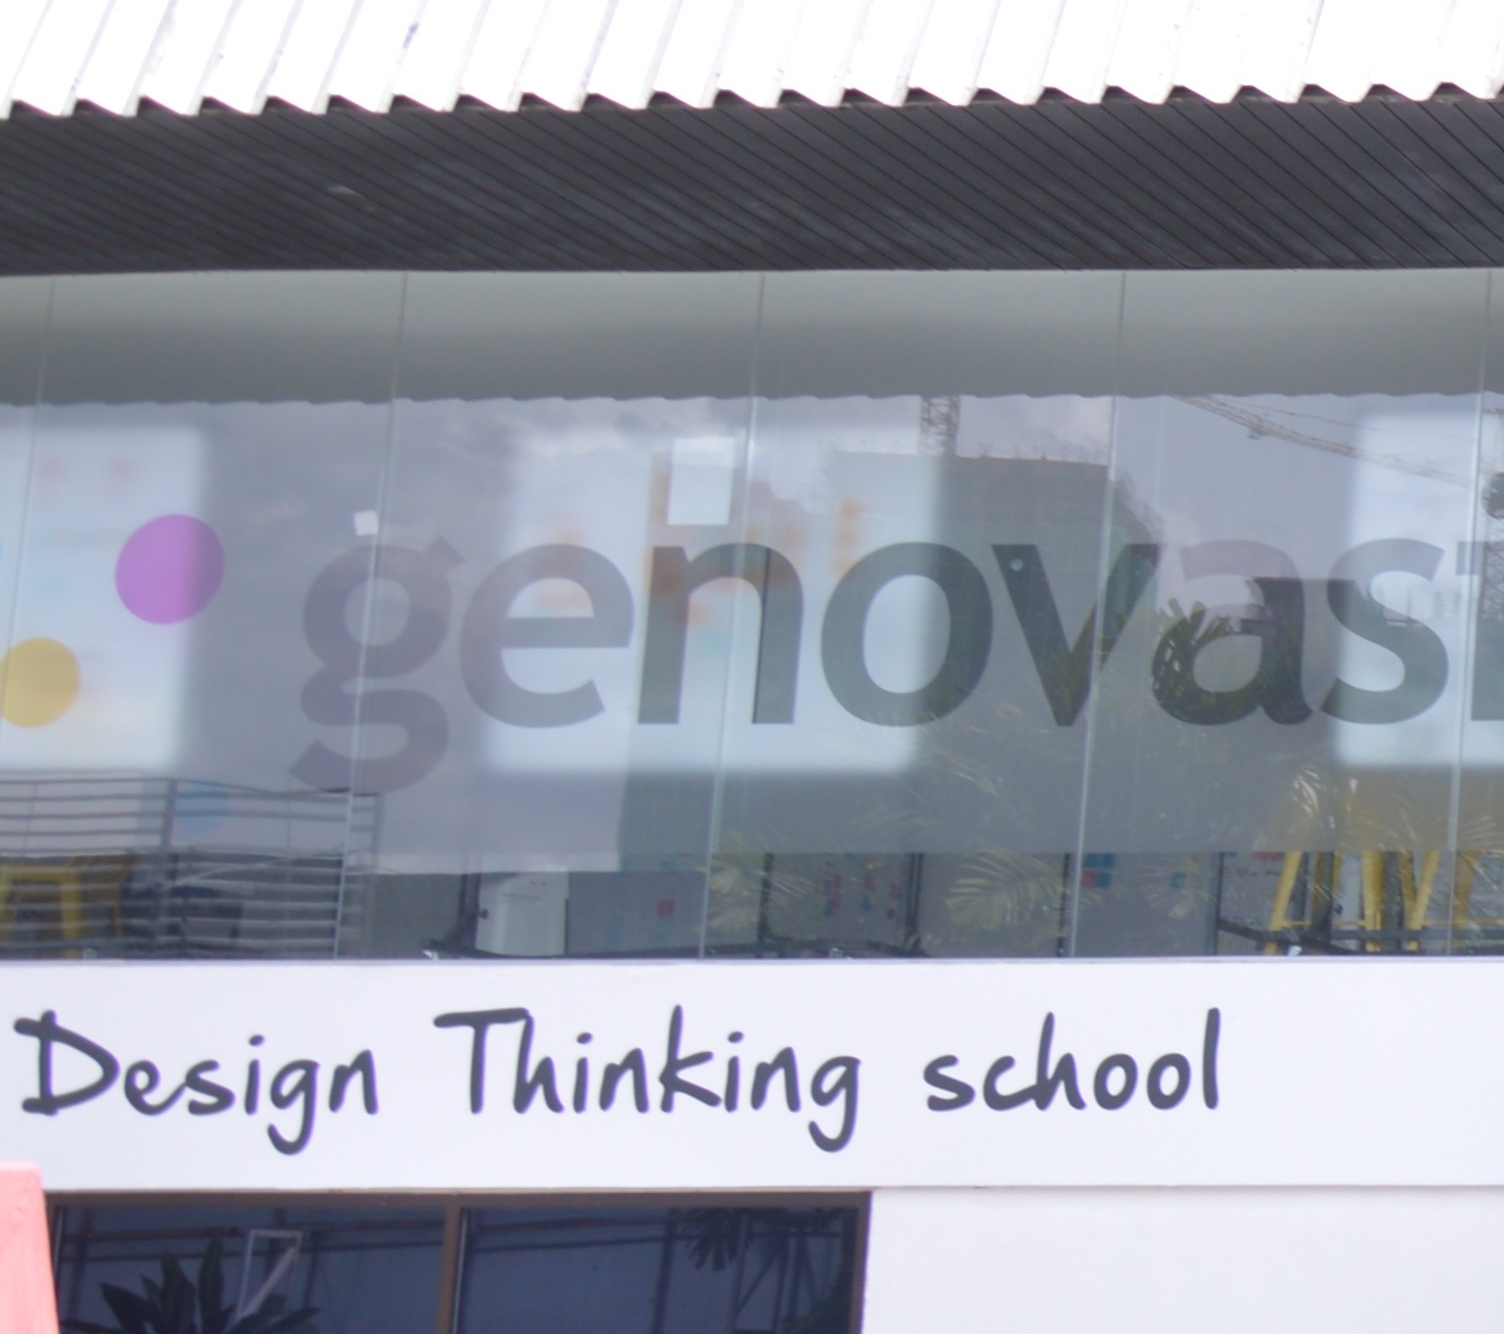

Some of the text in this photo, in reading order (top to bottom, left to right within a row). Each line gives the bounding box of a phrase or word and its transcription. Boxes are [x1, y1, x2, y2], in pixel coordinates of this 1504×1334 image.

[13, 1004, 1222, 1156] Design Thinking school
